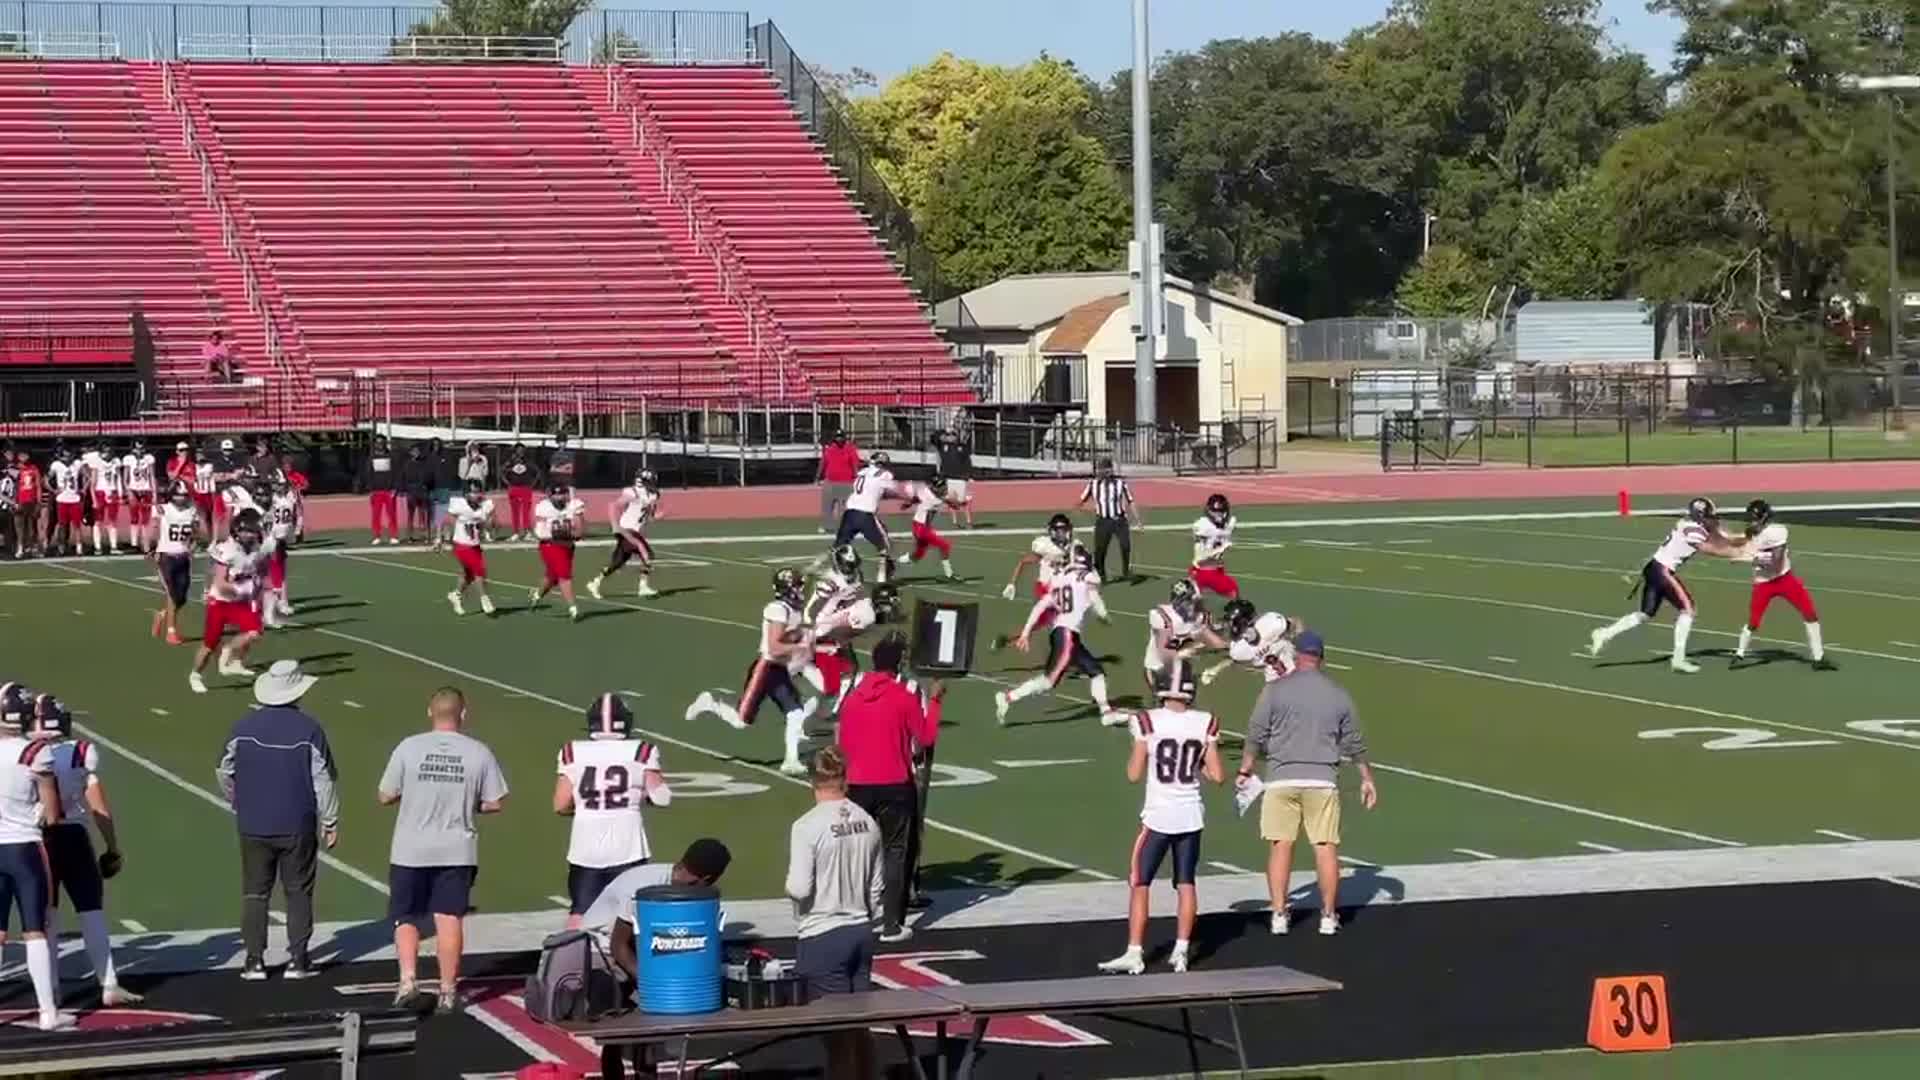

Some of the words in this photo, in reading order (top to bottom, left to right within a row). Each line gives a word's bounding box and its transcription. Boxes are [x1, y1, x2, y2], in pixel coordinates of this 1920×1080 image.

[934, 609, 958, 663] 1
[1156, 738, 1204, 784] 80
[579, 765, 629, 810] 42
[650, 936, 707, 953] POWERADE
[1610, 982, 1659, 1038] 30
